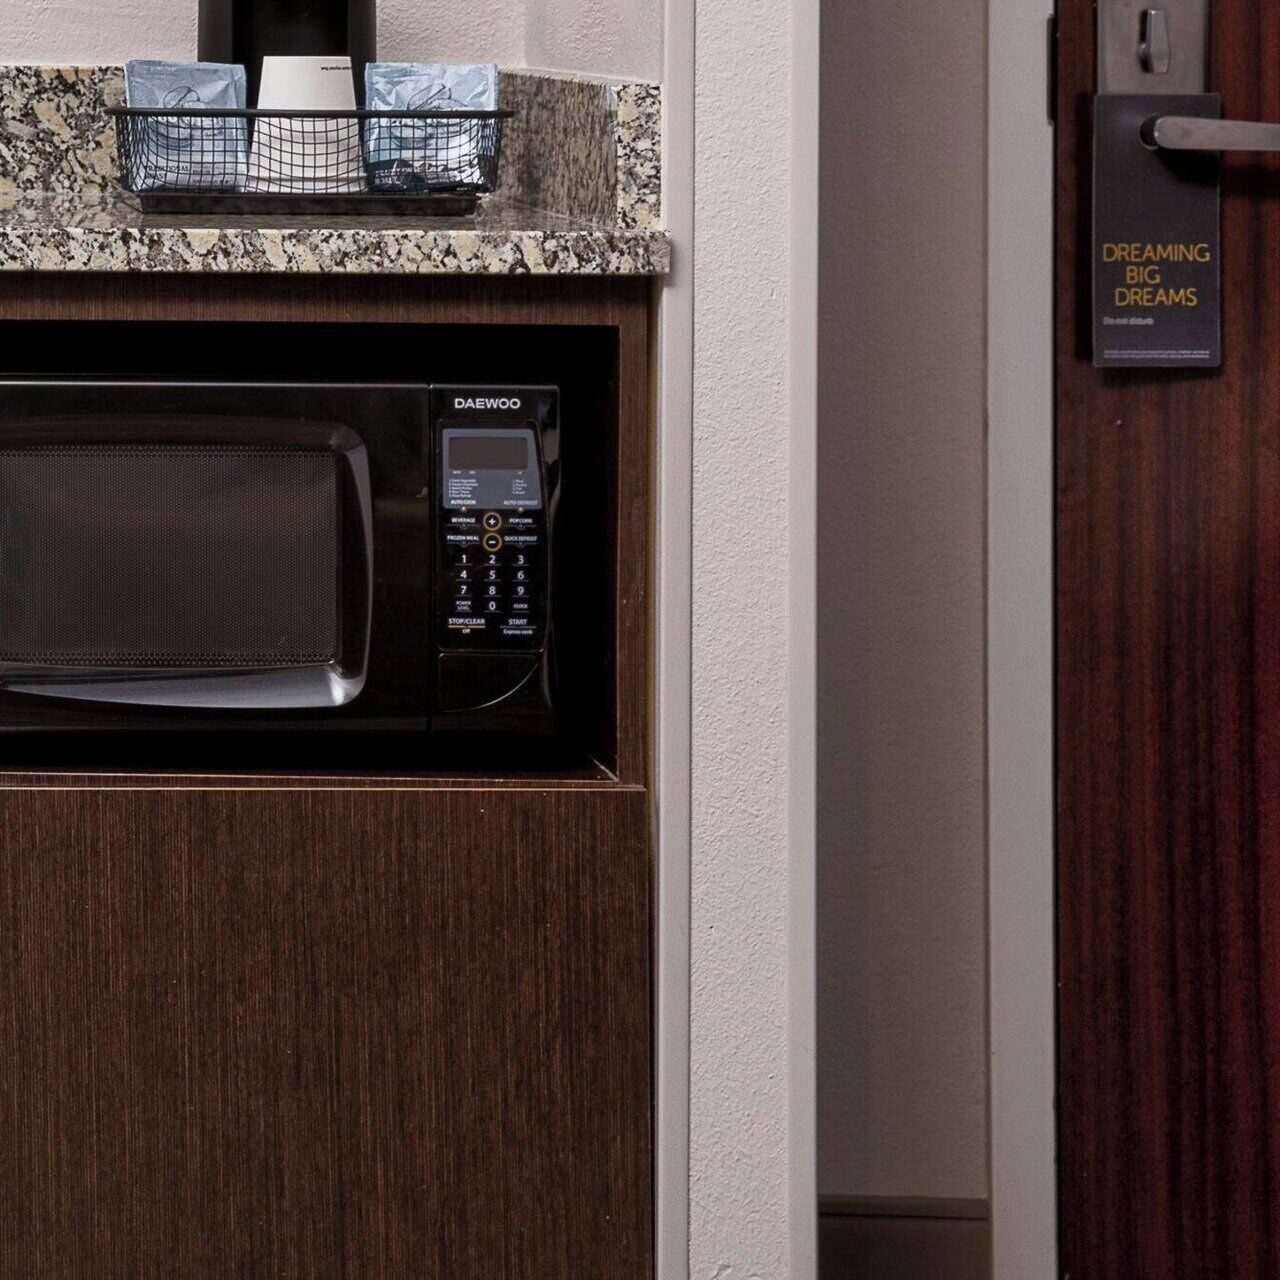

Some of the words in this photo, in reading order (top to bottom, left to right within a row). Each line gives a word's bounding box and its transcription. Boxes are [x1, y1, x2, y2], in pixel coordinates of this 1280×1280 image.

[1102, 243, 1211, 262] DREAMING
[1126, 265, 1161, 284] BIG
[1115, 287, 1198, 307] DREAMS
[454, 398, 521, 409] DAEWOO
[462, 554, 467, 564] 1
[489, 554, 496, 564] 2
[517, 555, 524, 565] 3
[460, 570, 467, 579] 4
[489, 570, 496, 580] 5
[517, 570, 525, 580] 6
[460, 585, 467, 595] 7
[489, 585, 496, 595] 8
[517, 585, 525, 596] 9
[489, 601, 496, 611] 0
